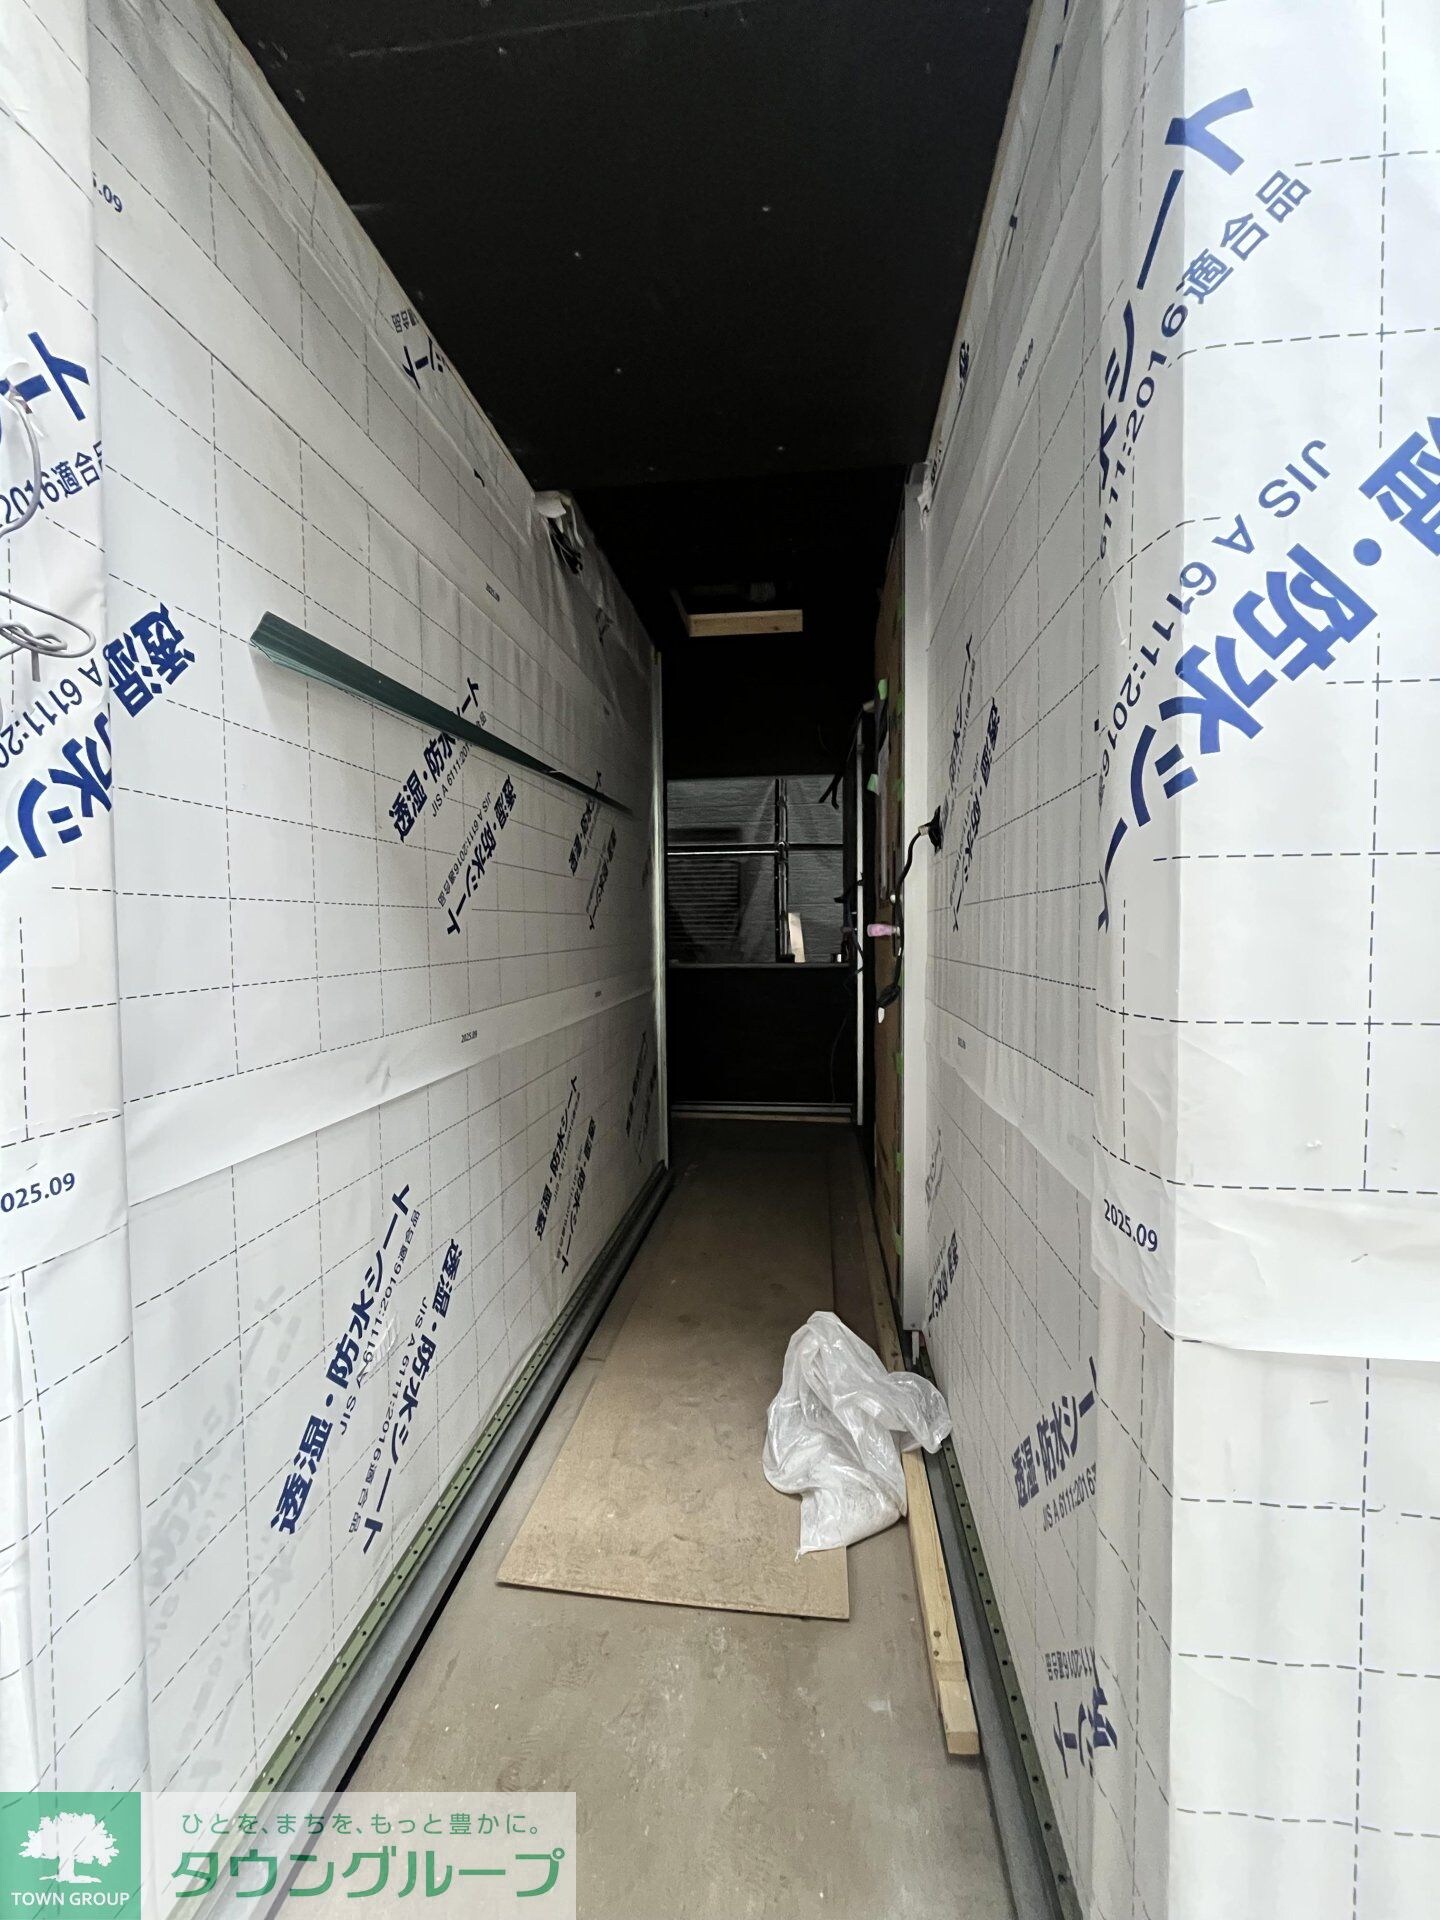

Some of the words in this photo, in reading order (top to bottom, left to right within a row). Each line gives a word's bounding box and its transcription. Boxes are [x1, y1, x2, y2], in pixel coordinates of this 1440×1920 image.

[92, 174, 123, 213] .09
[1258, 439, 1332, 518] JIS
[1211, 514, 1255, 555] A
[1098, 561, 1218, 806] 6111:2016
[431, 793, 443, 818] JIS
[0, 1172, 76, 1213] 025.09
[1103, 1198, 1158, 1253] 2025.09
[270, 1184, 410, 1535] 透湿・防水シート
[339, 1395, 357, 1436] JIS
[362, 1238, 461, 1554] 透湿・防水シート
